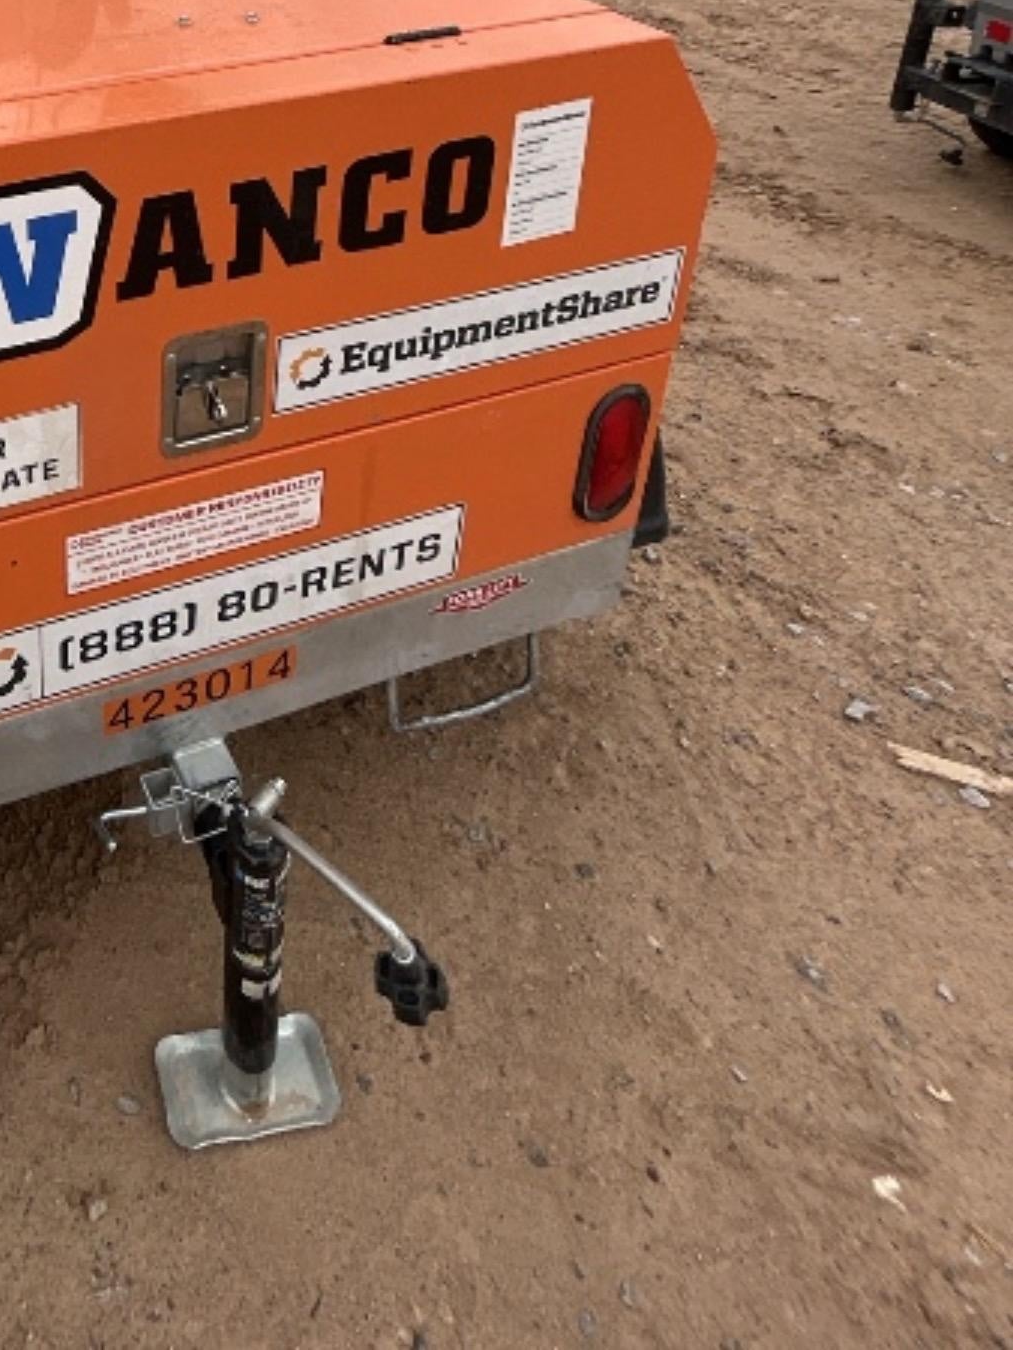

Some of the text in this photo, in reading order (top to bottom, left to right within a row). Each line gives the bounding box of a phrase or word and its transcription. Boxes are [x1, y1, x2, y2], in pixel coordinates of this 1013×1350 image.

[339, 280, 661, 374] EquipmentShare
[58, 601, 197, 671] (888)
[216, 532, 442, 623] 80-RENTS
[108, 650, 292, 731] 423014
